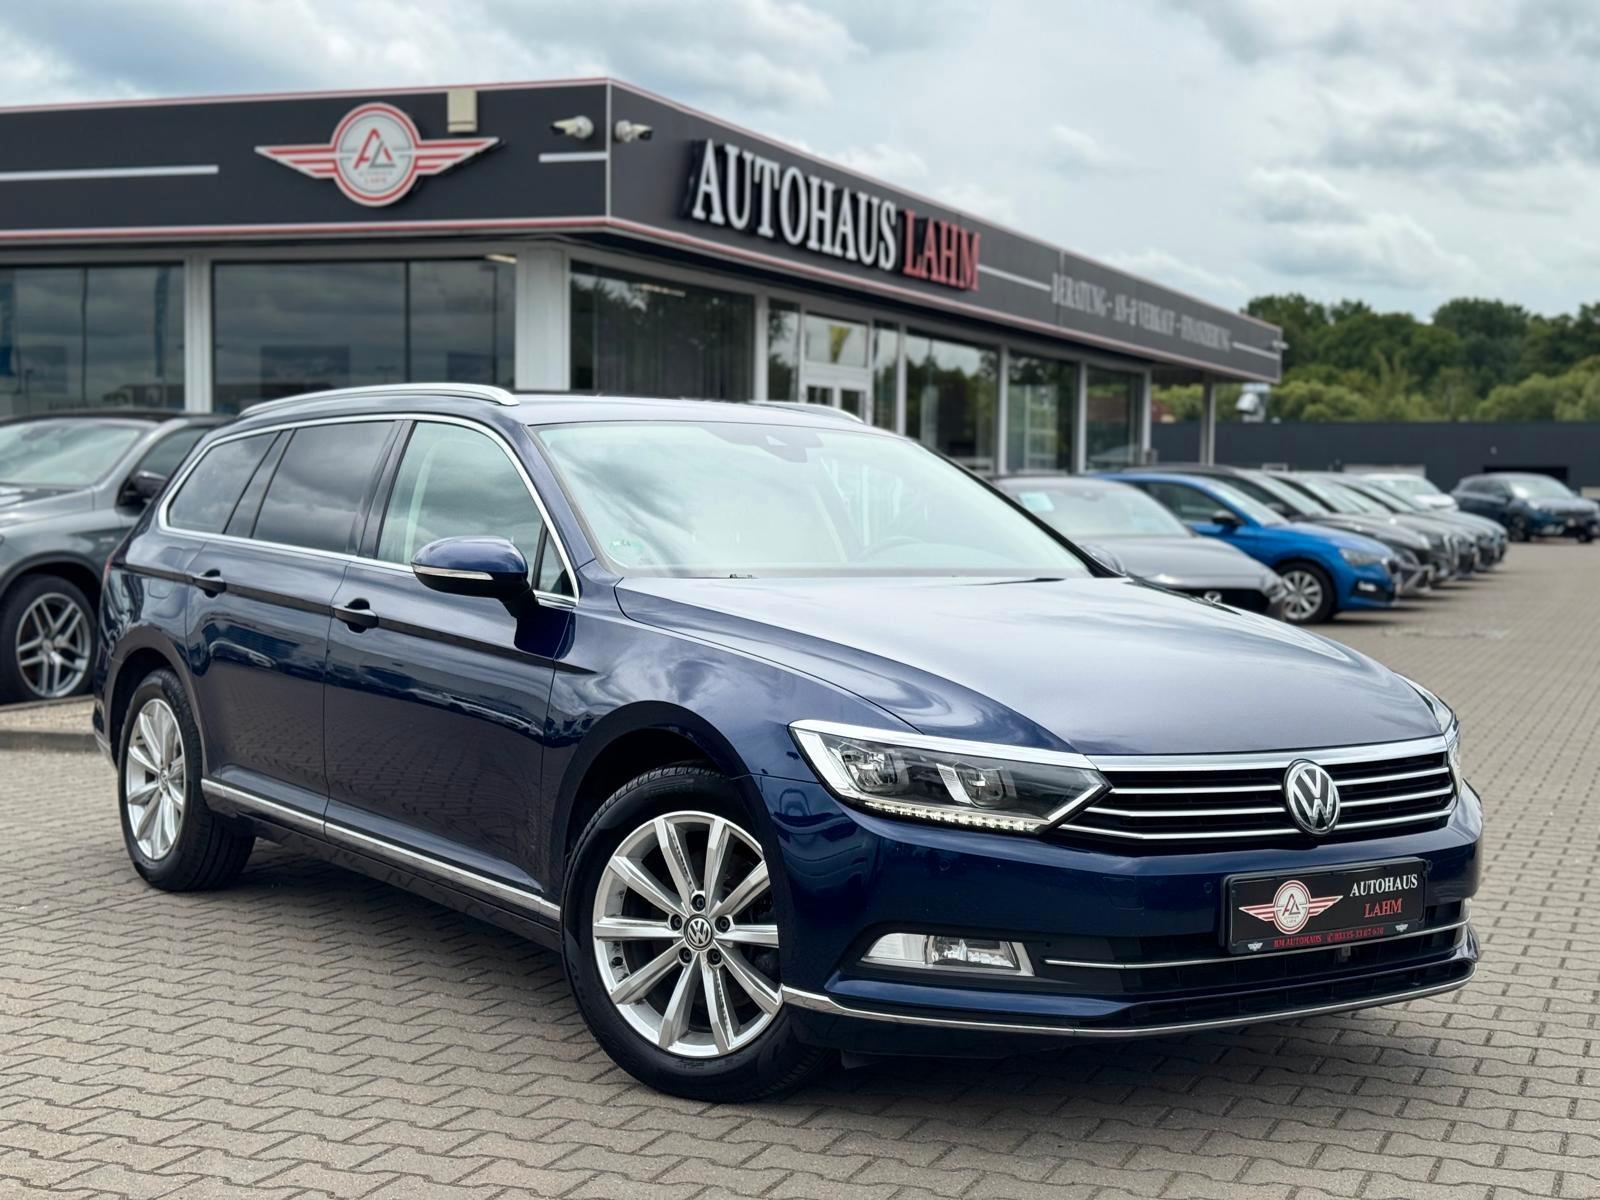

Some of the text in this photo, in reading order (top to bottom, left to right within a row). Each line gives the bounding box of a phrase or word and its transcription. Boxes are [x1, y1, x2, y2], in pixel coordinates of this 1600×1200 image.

[692, 138, 981, 292] AUTOHAUS LAHM
[1350, 873, 1418, 897] AUTOHAUS
[1363, 898, 1403, 918] LAHM
